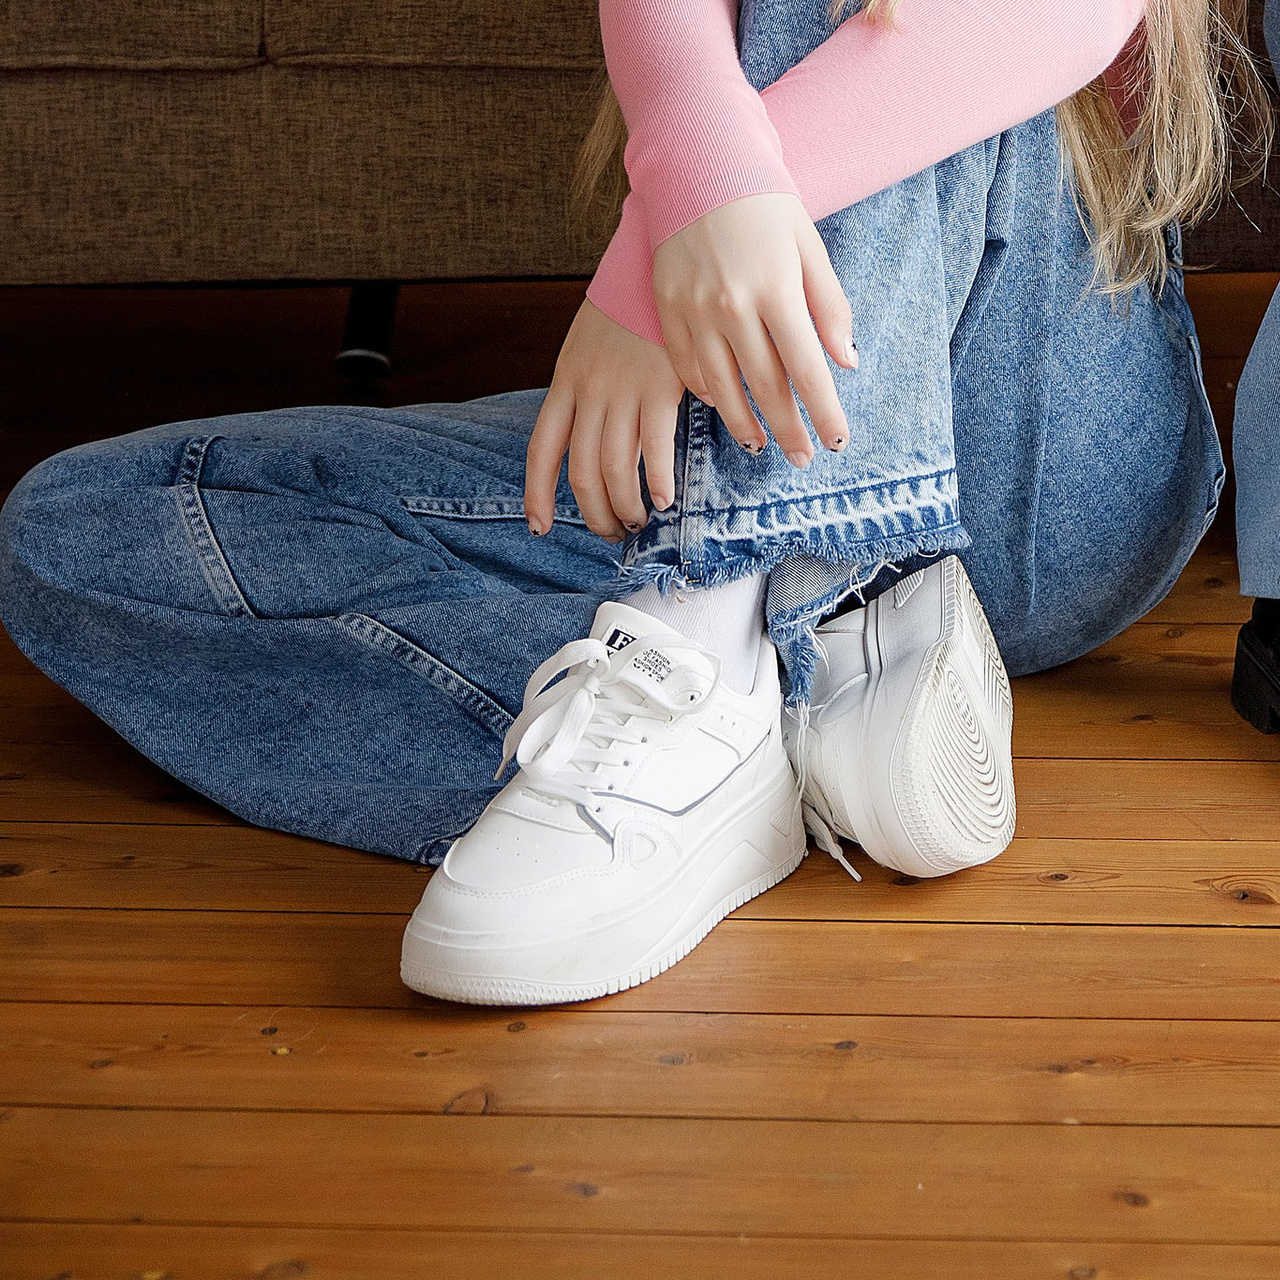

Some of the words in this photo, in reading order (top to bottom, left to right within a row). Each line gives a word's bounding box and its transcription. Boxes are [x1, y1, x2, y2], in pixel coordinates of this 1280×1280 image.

[634, 657, 652, 672] ASHION
[642, 655, 663, 673] SHOES
[649, 648, 671, 666] ASHION
[651, 654, 672, 674] FASHIO
